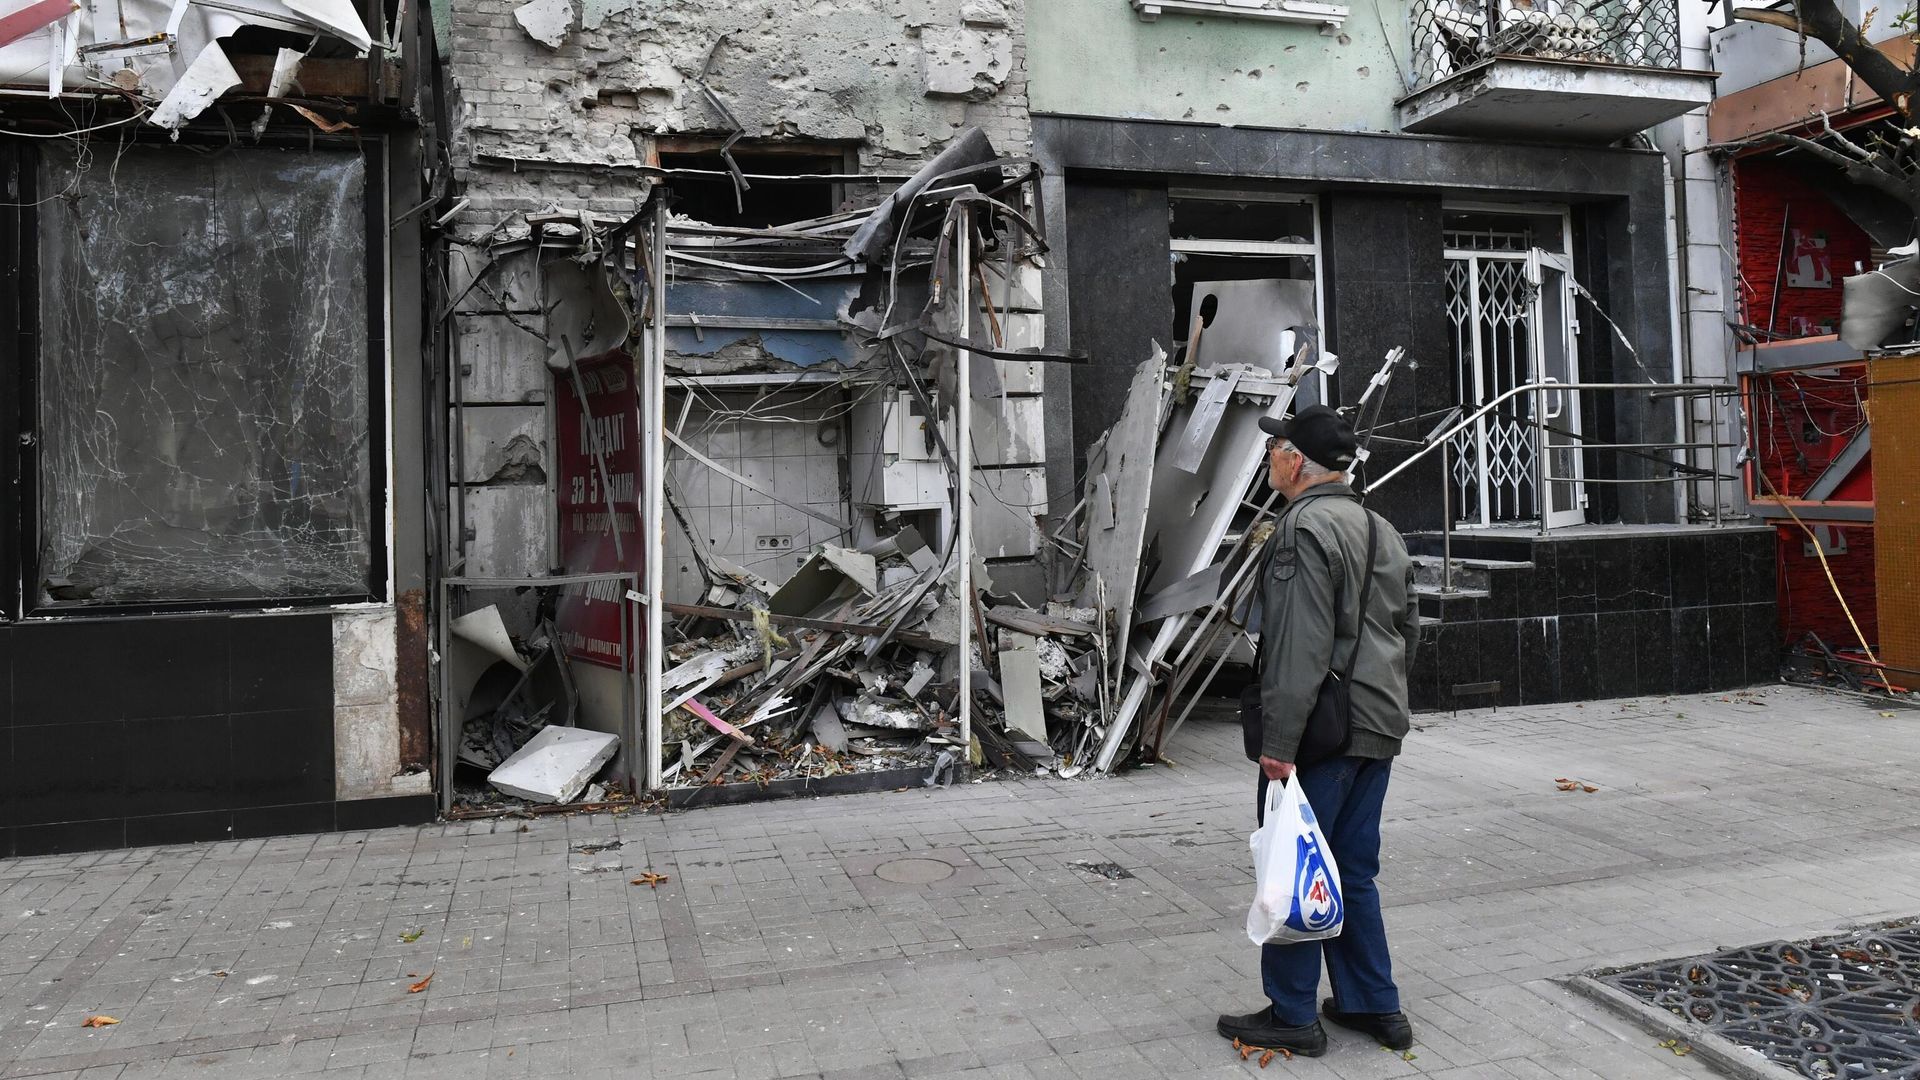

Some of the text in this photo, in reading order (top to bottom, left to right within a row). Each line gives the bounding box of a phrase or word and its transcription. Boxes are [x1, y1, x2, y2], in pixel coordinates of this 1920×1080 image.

[580, 411, 624, 466] Кредит
[571, 475, 585, 505] за
[590, 468, 598, 504] 5
